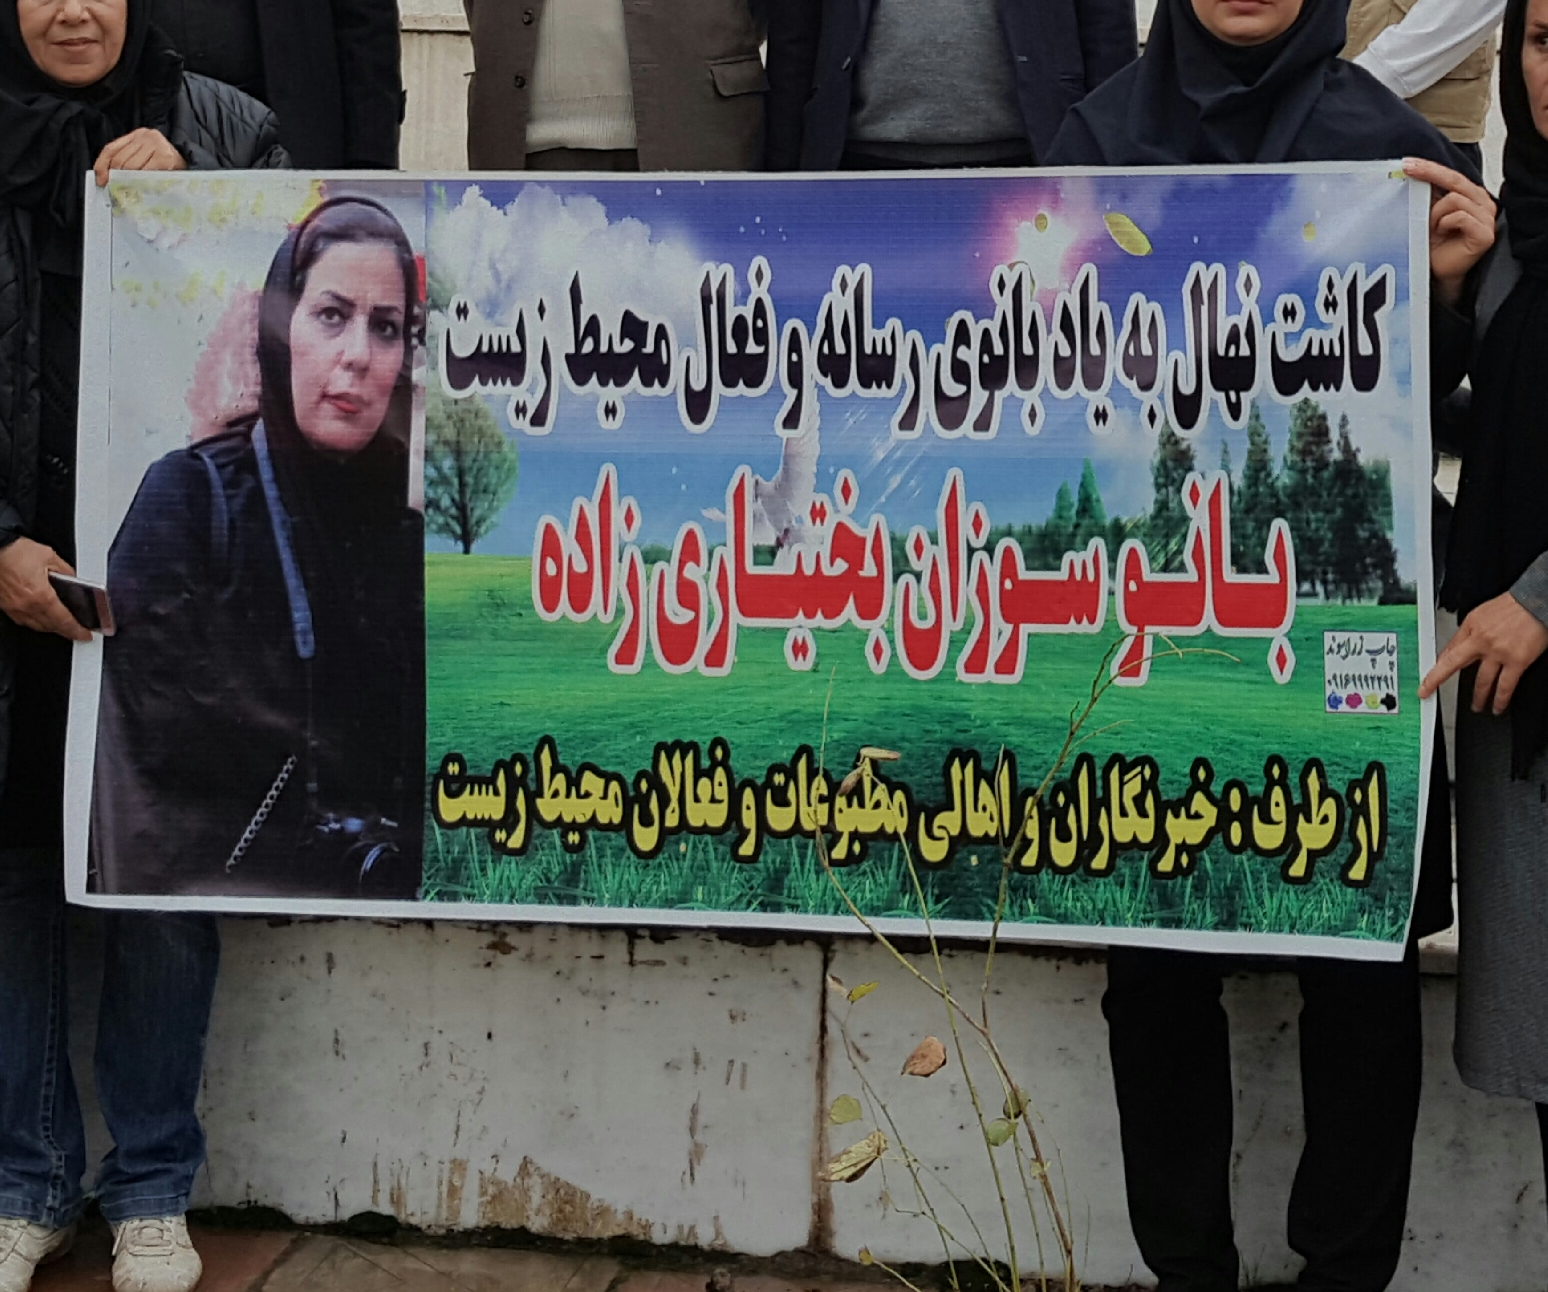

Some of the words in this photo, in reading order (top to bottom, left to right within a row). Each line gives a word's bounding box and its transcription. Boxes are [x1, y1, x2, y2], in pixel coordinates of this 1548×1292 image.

[444, 297, 554, 429] زیست
[563, 269, 673, 422] محیط
[682, 260, 774, 427] فعال
[777, 324, 807, 431] و
[815, 269, 920, 433] رسانه
[933, 269, 1041, 433] بانوی
[1051, 268, 1108, 428] یاد
[1121, 300, 1159, 429] به
[1170, 268, 1256, 431] نهال
[1268, 269, 1391, 398] کاشت
[537, 469, 642, 668] زاده
[656, 470, 887, 670] بختیاری
[900, 473, 1103, 676] سوزان
[1116, 476, 1290, 680] بانو
[1364, 635, 1396, 672] چاپ
[437, 760, 527, 851] زیست
[535, 741, 624, 846] محیط
[632, 744, 730, 853] فعالان
[736, 784, 757, 857] و
[765, 751, 910, 861] مطبوعات
[917, 755, 1012, 864] اهالی
[1019, 790, 1041, 868] و
[1048, 759, 1219, 873] خبرنگاران
[1348, 767, 1382, 882] از
